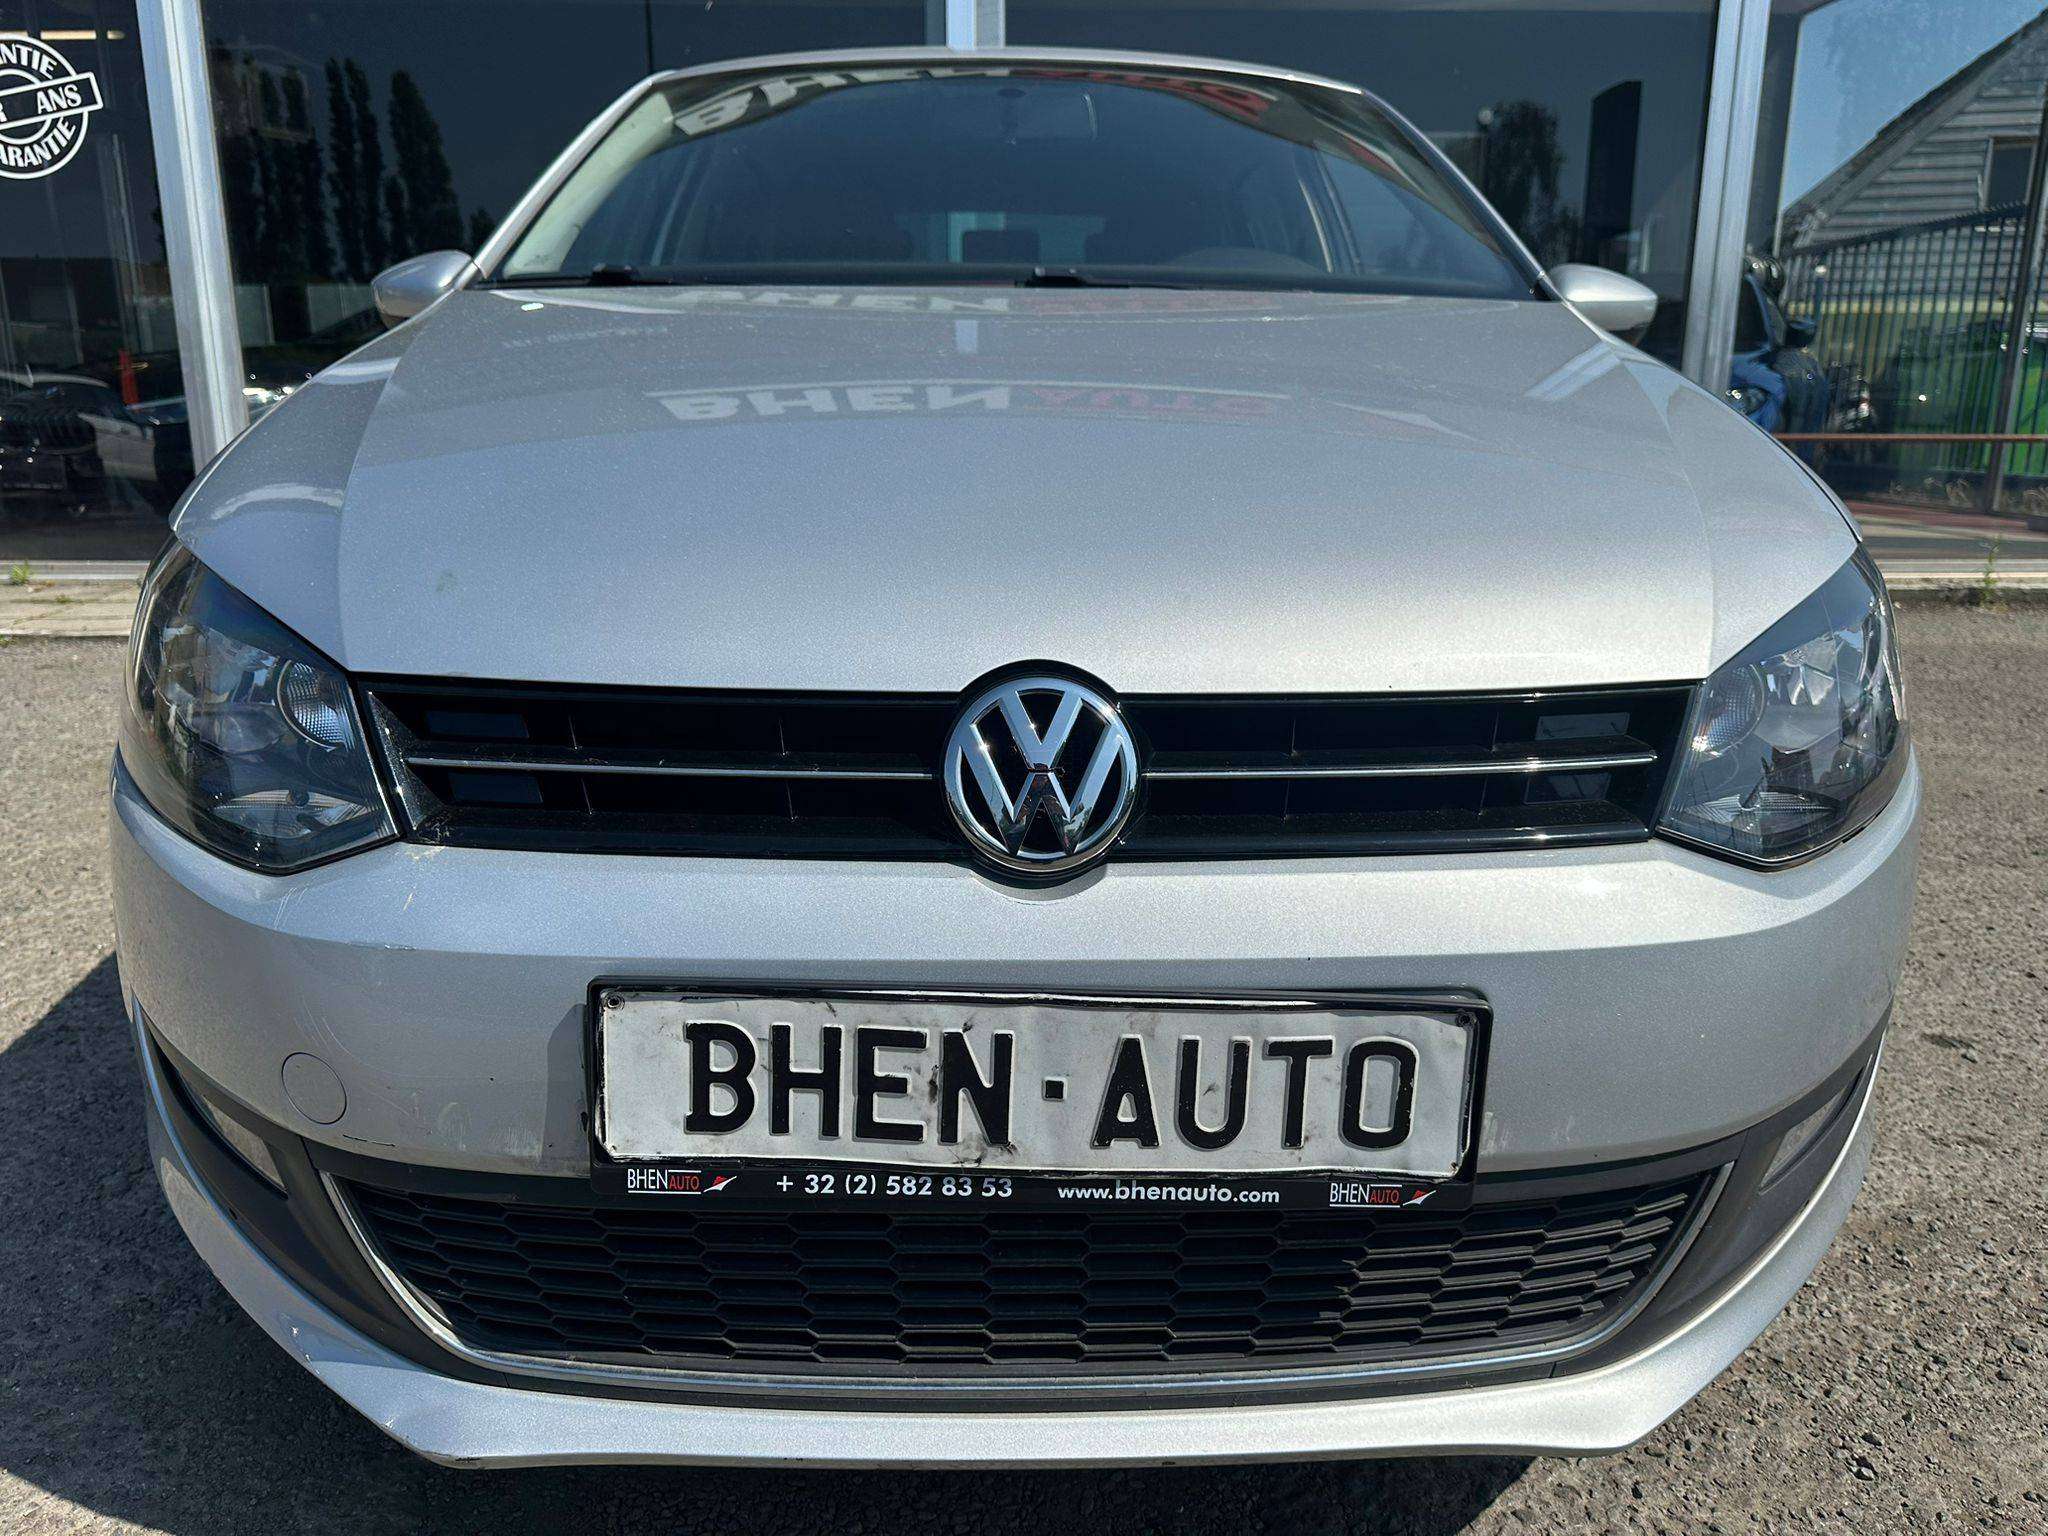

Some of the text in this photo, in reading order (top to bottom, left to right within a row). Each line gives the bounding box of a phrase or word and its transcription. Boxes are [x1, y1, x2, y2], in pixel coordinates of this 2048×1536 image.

[0, 43, 57, 79] NTIE
[36, 84, 82, 114] ANS
[684, 1020, 1015, 1146] BHEN
[1091, 1034, 1419, 1150] AUTO
[804, 1174, 835, 1194] 32
[845, 1174, 876, 1195] (2)
[886, 1175, 932, 1196] 582
[941, 1176, 973, 1197] 83
[981, 1177, 1013, 1198] 53
[1057, 1179, 1280, 1203] www.bhenauto.com
